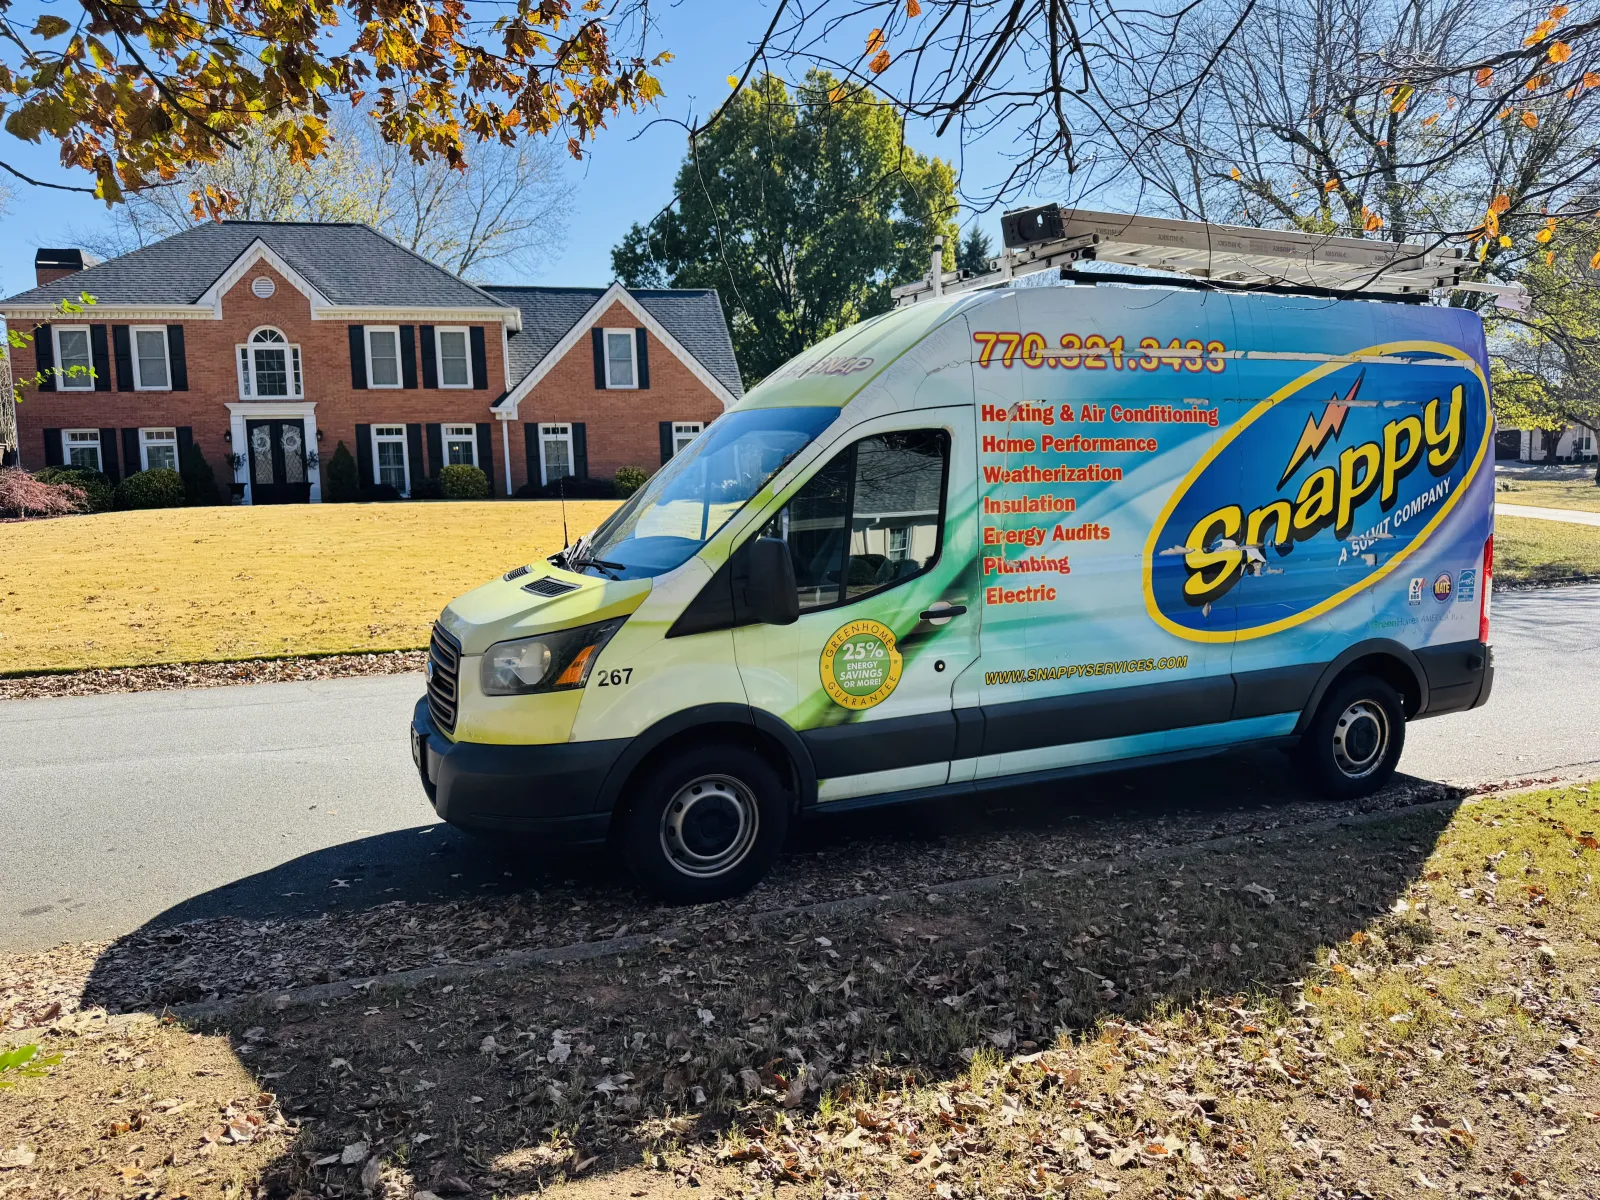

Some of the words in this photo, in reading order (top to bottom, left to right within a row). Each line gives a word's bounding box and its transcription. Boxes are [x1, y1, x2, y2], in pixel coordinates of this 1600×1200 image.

[1157, 234, 1180, 242] HUSKY
[1217, 240, 1237, 248] HUSKY
[1325, 250, 1344, 258] HUSKY
[973, 331, 1227, 373] 770.321.3433
[1059, 404, 1075, 422] &
[1080, 405, 1104, 422] Air
[1110, 404, 1219, 427] Conditioning
[982, 434, 1036, 453] Home
[1041, 433, 1158, 453] Performance
[983, 463, 1123, 484] Weatherization
[1183, 382, 1466, 603] Snappy
[983, 494, 1076, 515] Insulation
[1338, 547, 1348, 566] A
[1351, 517, 1391, 557] SOLVIT
[1393, 476, 1451, 528] COMPANY
[1052, 523, 1111, 542] Audits
[983, 555, 1072, 576] Plumbing
[985, 584, 1057, 605] Electric
[1435, 582, 1451, 594] NATE
[842, 641, 884, 660] 25%
[840, 668, 883, 681] SAVINGS
[846, 661, 878, 671] ENERGY
[984, 655, 1189, 685] WWW.SNAPPYSERVICES.COM
[597, 667, 634, 687] 267
[843, 680, 855, 688] OR
[856, 678, 881, 687] MORE!
[828, 675, 897, 706] GUARANTEE
